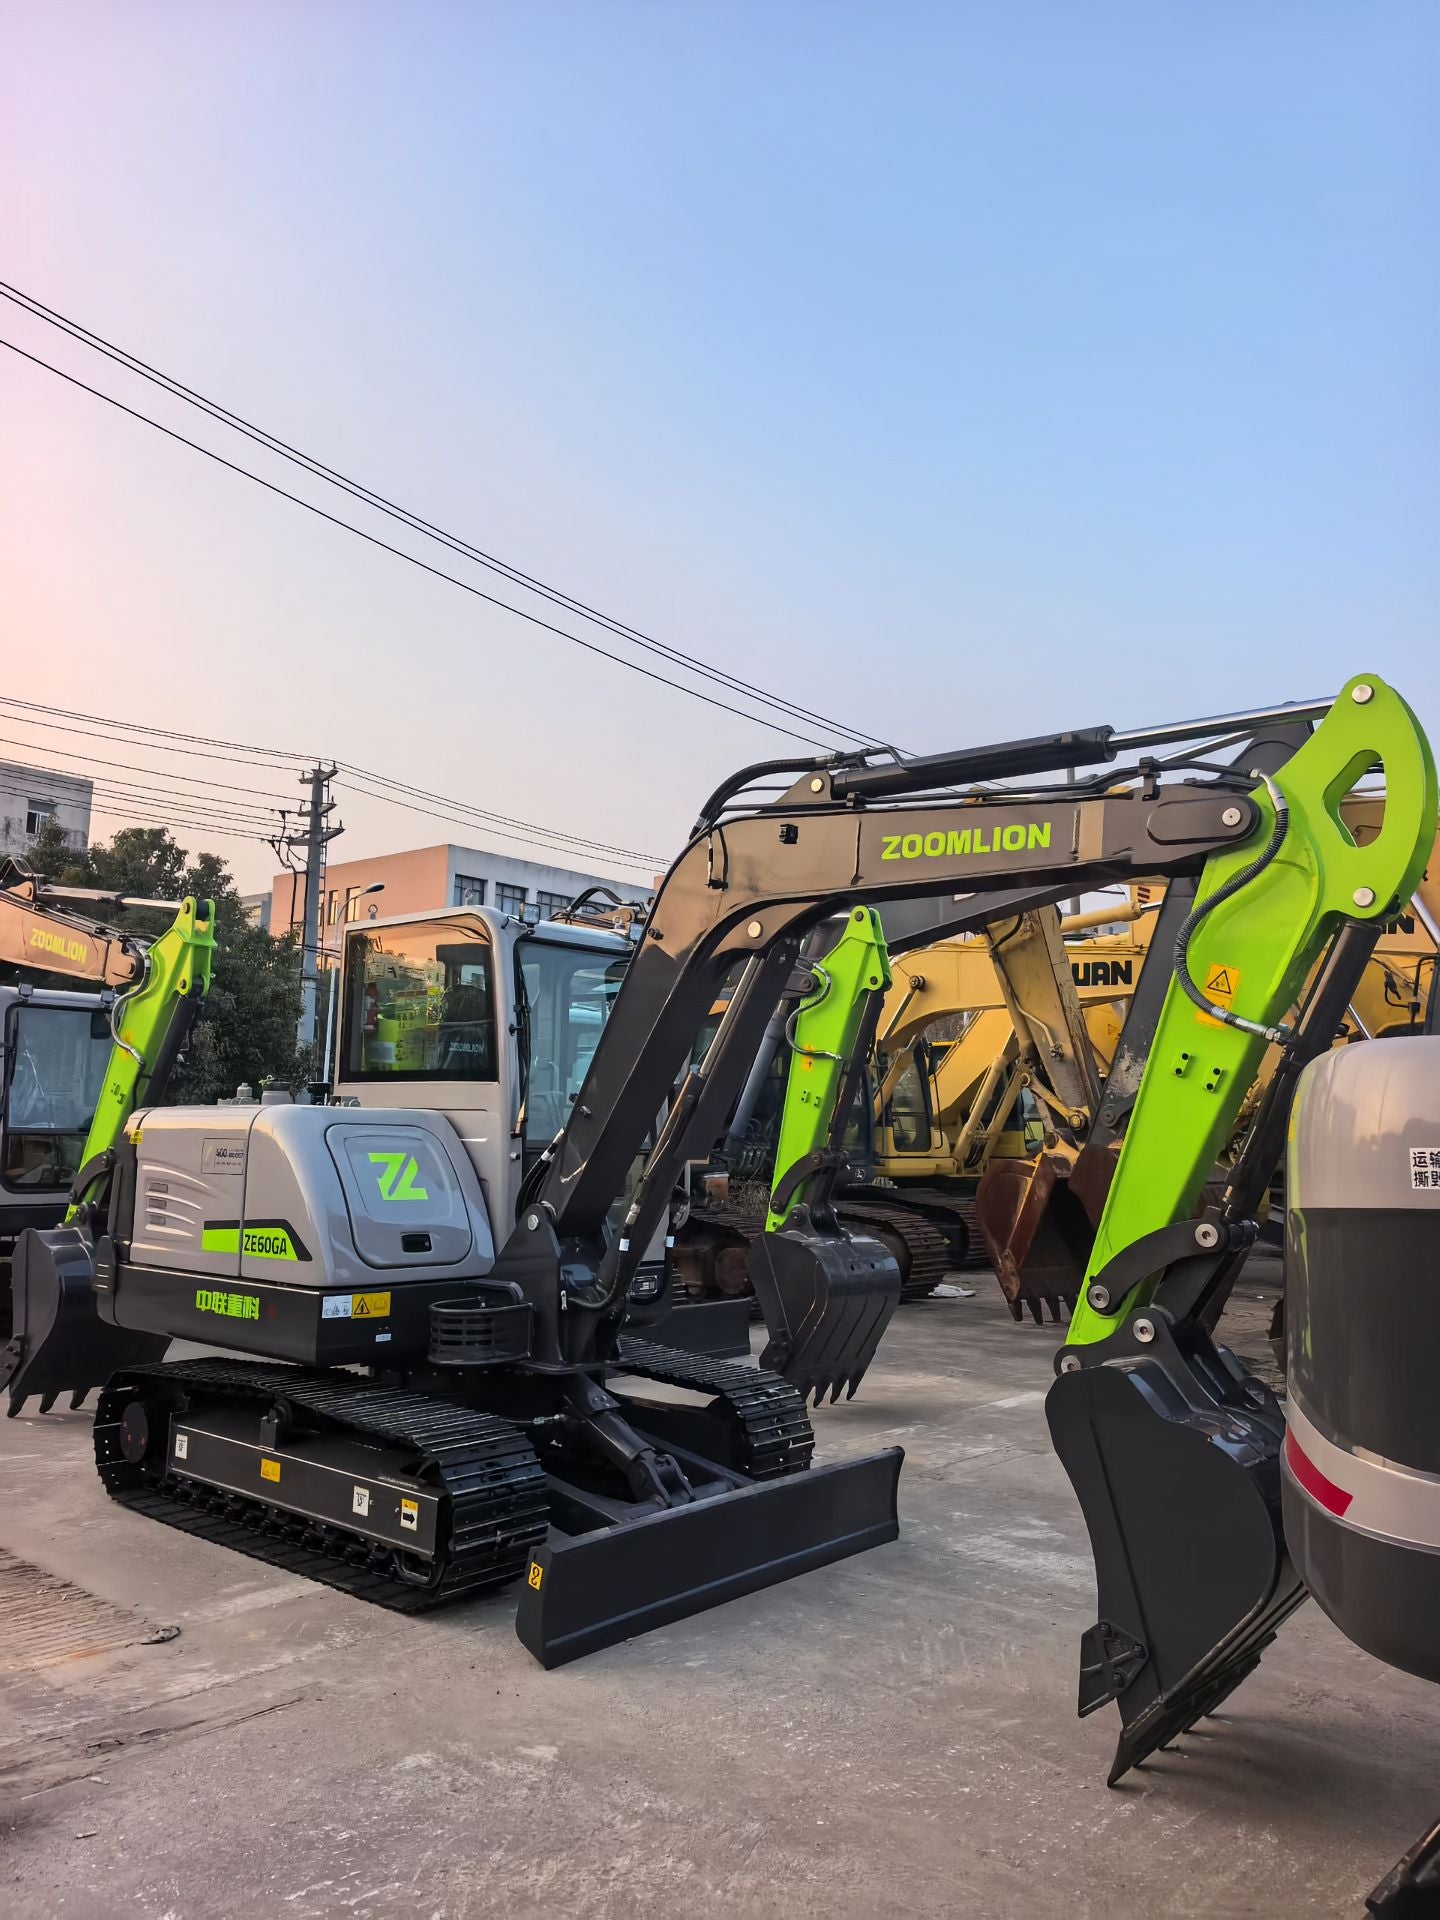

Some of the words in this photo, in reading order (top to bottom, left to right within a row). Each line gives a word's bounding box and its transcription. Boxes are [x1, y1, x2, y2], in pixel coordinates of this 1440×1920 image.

[881, 822, 1052, 860] ZOOMLION
[30, 928, 87, 964] ZOOMLION
[243, 1234, 287, 1255] ZE60GA
[196, 1290, 259, 1320] 中联重科
